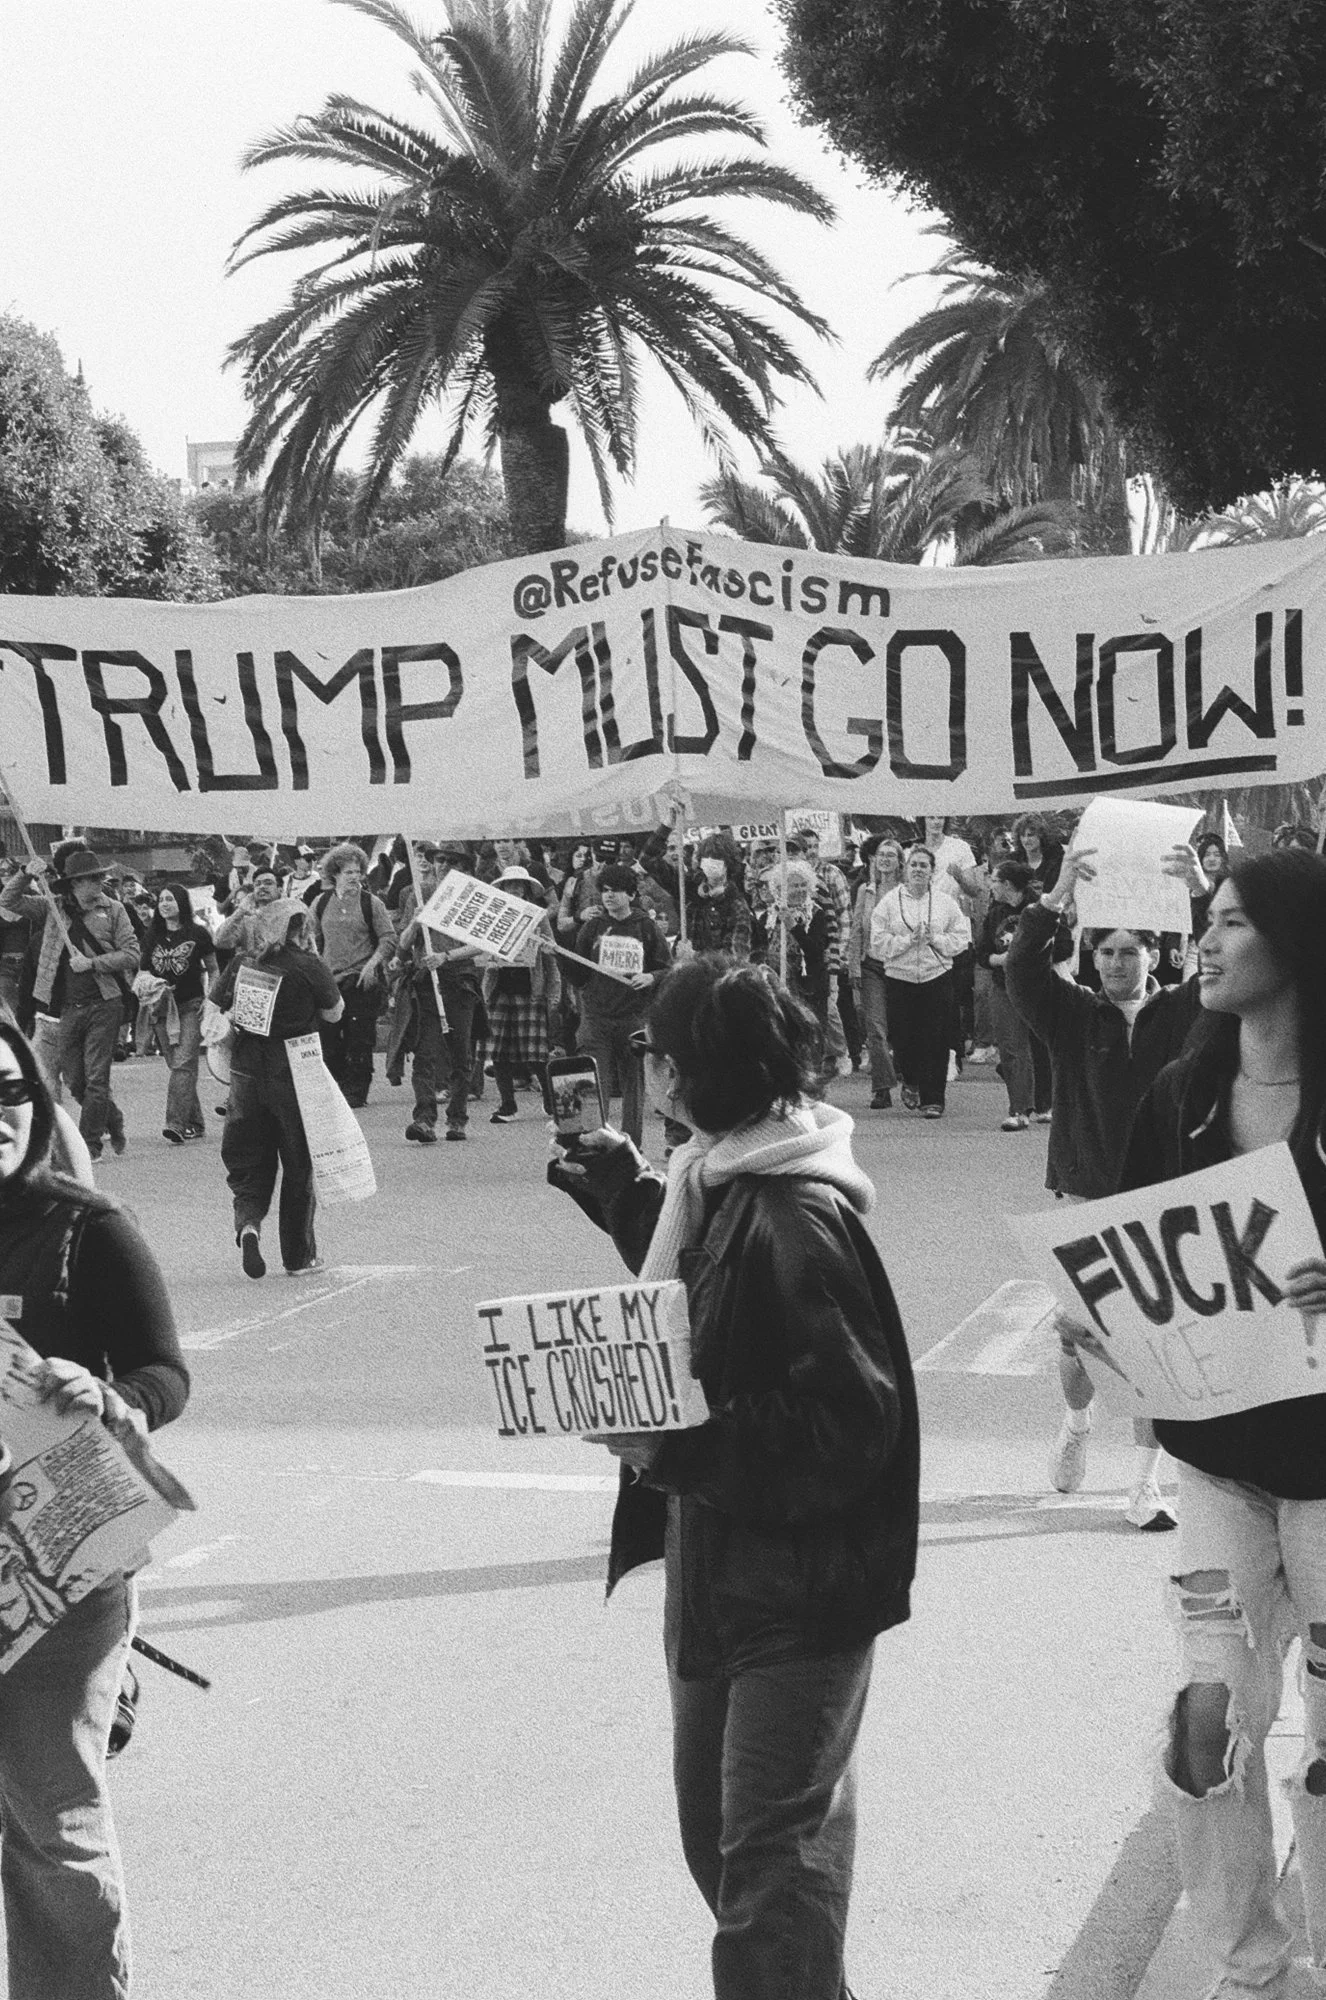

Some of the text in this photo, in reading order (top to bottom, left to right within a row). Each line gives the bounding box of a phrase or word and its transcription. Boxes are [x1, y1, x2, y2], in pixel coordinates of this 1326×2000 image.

[513, 540, 890, 619] @RefuseFascism
[0, 604, 1305, 793] TRUMP MUST GO NOW!
[740, 823, 778, 840] GREAT
[454, 891, 487, 929] REGISTER
[470, 897, 506, 939] PEACE AND
[487, 907, 520, 944] FREEDOM
[1052, 1197, 1284, 1337] FUCK
[478, 1289, 660, 1353] I LIKE MY
[485, 1341, 680, 1436] ICE CRUSHED!
